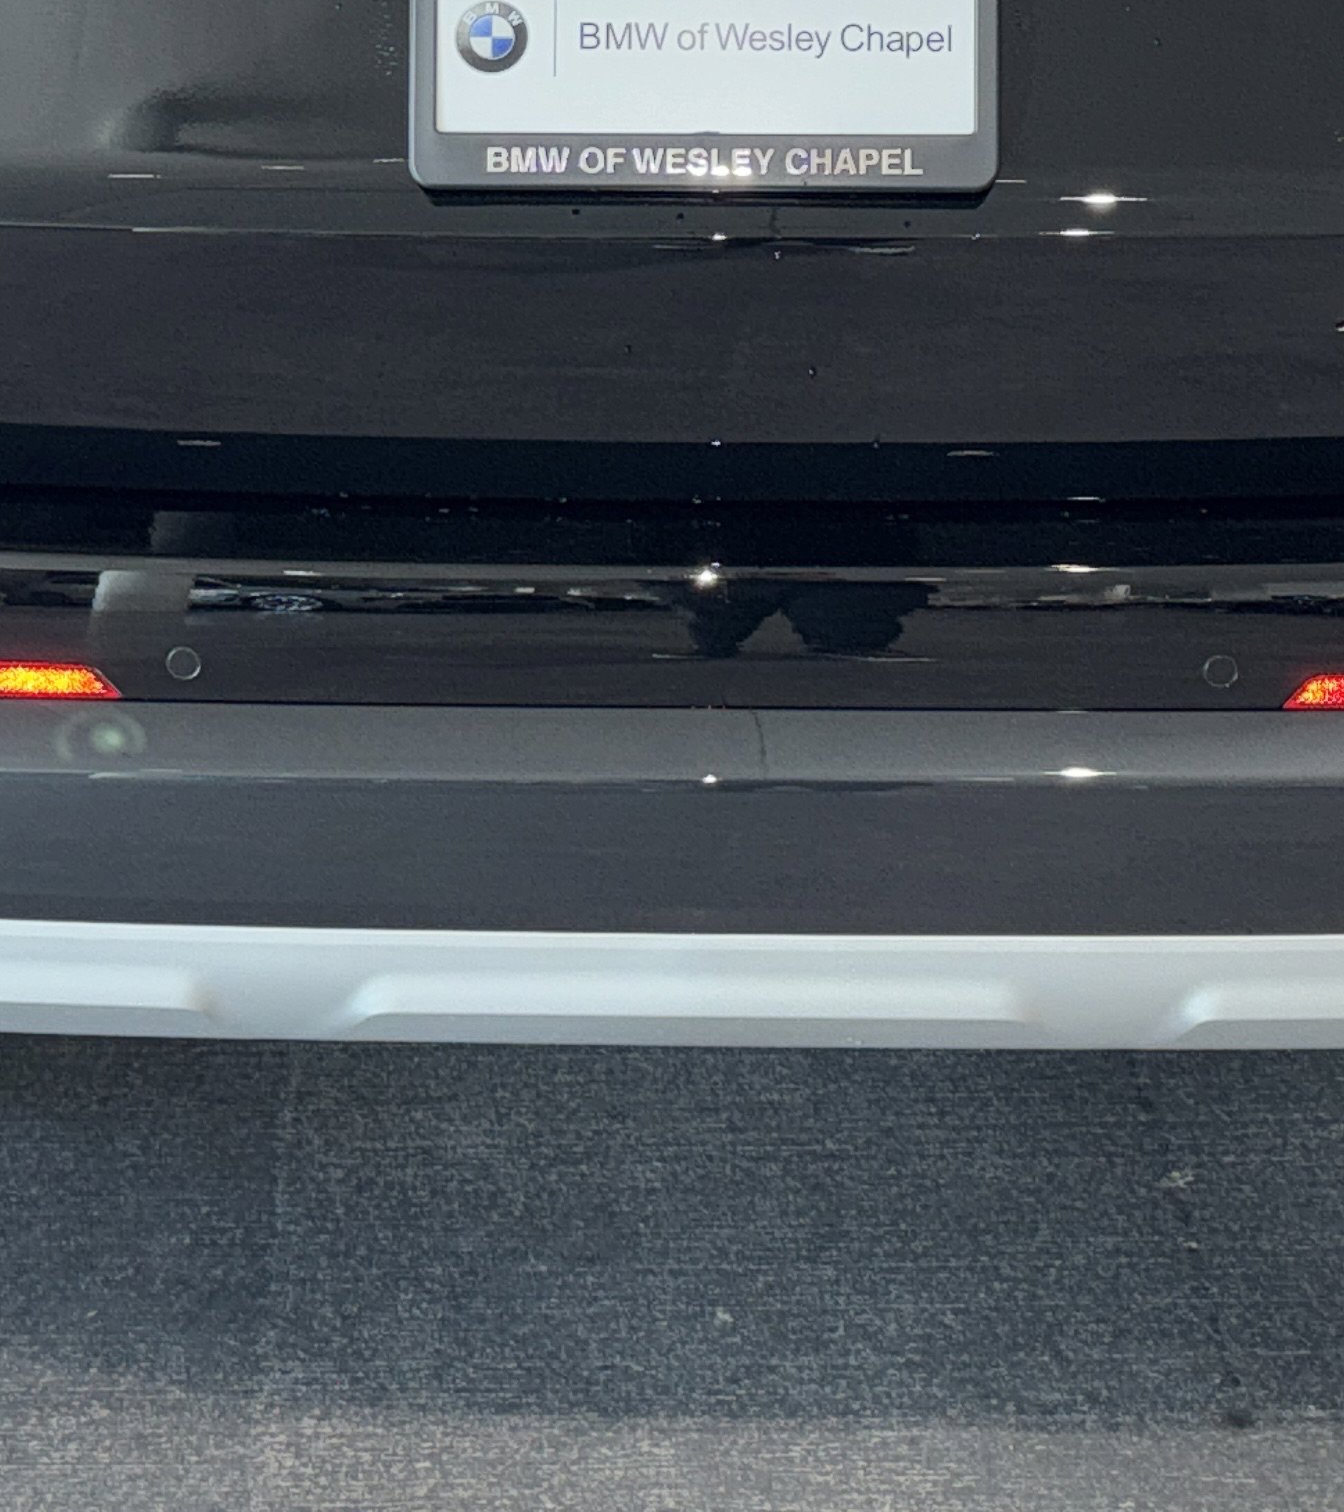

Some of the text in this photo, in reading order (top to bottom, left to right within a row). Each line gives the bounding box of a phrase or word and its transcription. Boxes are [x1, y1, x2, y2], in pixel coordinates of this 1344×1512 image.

[462, 2, 523, 26] BMW
[579, 22, 953, 59] BMW of Wesley Chapel
[486, 146, 924, 176] BMW OF WESLEY CHAPEL
